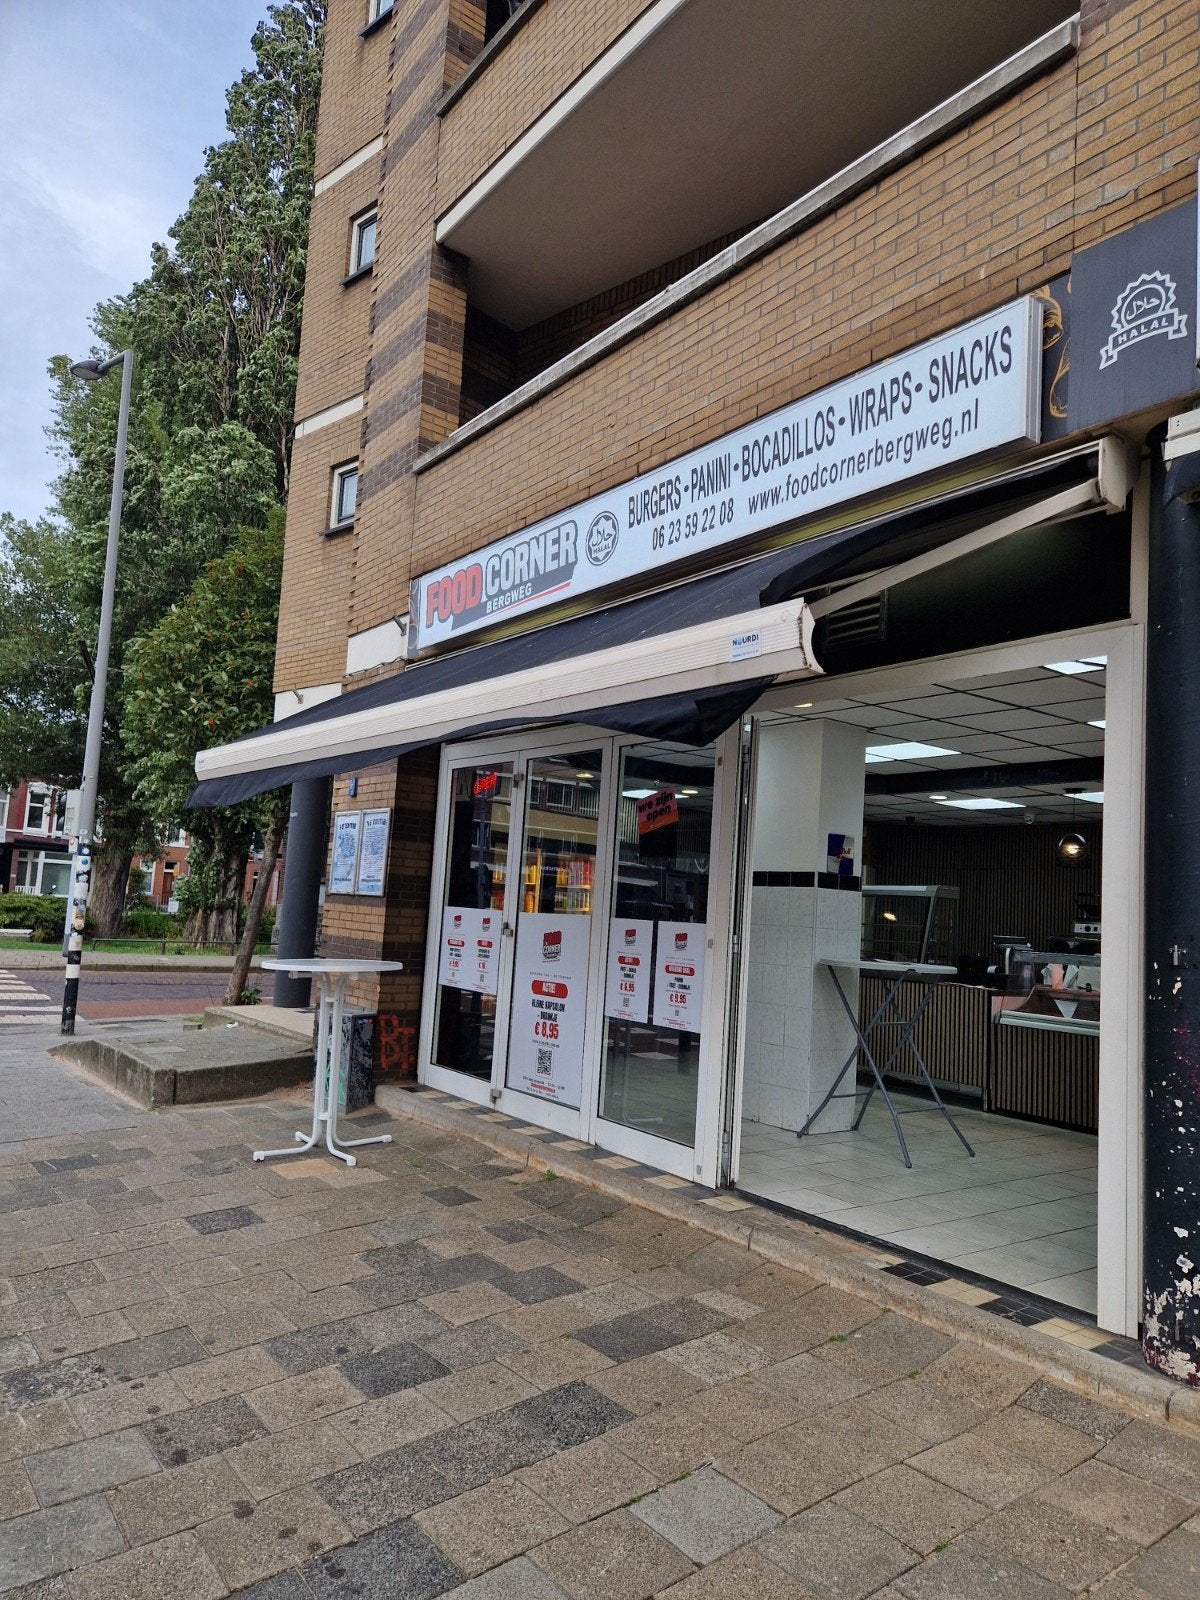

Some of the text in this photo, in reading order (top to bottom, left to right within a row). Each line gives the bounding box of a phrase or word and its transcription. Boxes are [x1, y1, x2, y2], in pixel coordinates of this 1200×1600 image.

[1118, 317, 1169, 344] HALAL
[628, 325, 1012, 529] BURGERS PANINI BOCADILLOS WRAPS SNACKS
[652, 398, 979, 551] 06 23 59 22 08 www.foodcornerbergweg.nl
[593, 543, 611, 554] HALAL
[426, 520, 578, 629] FOOD CORNER
[486, 583, 532, 613] BERGWEG
[656, 791, 673, 806] zijn
[647, 804, 671, 821] open
[535, 1021, 559, 1039] € 8,95
